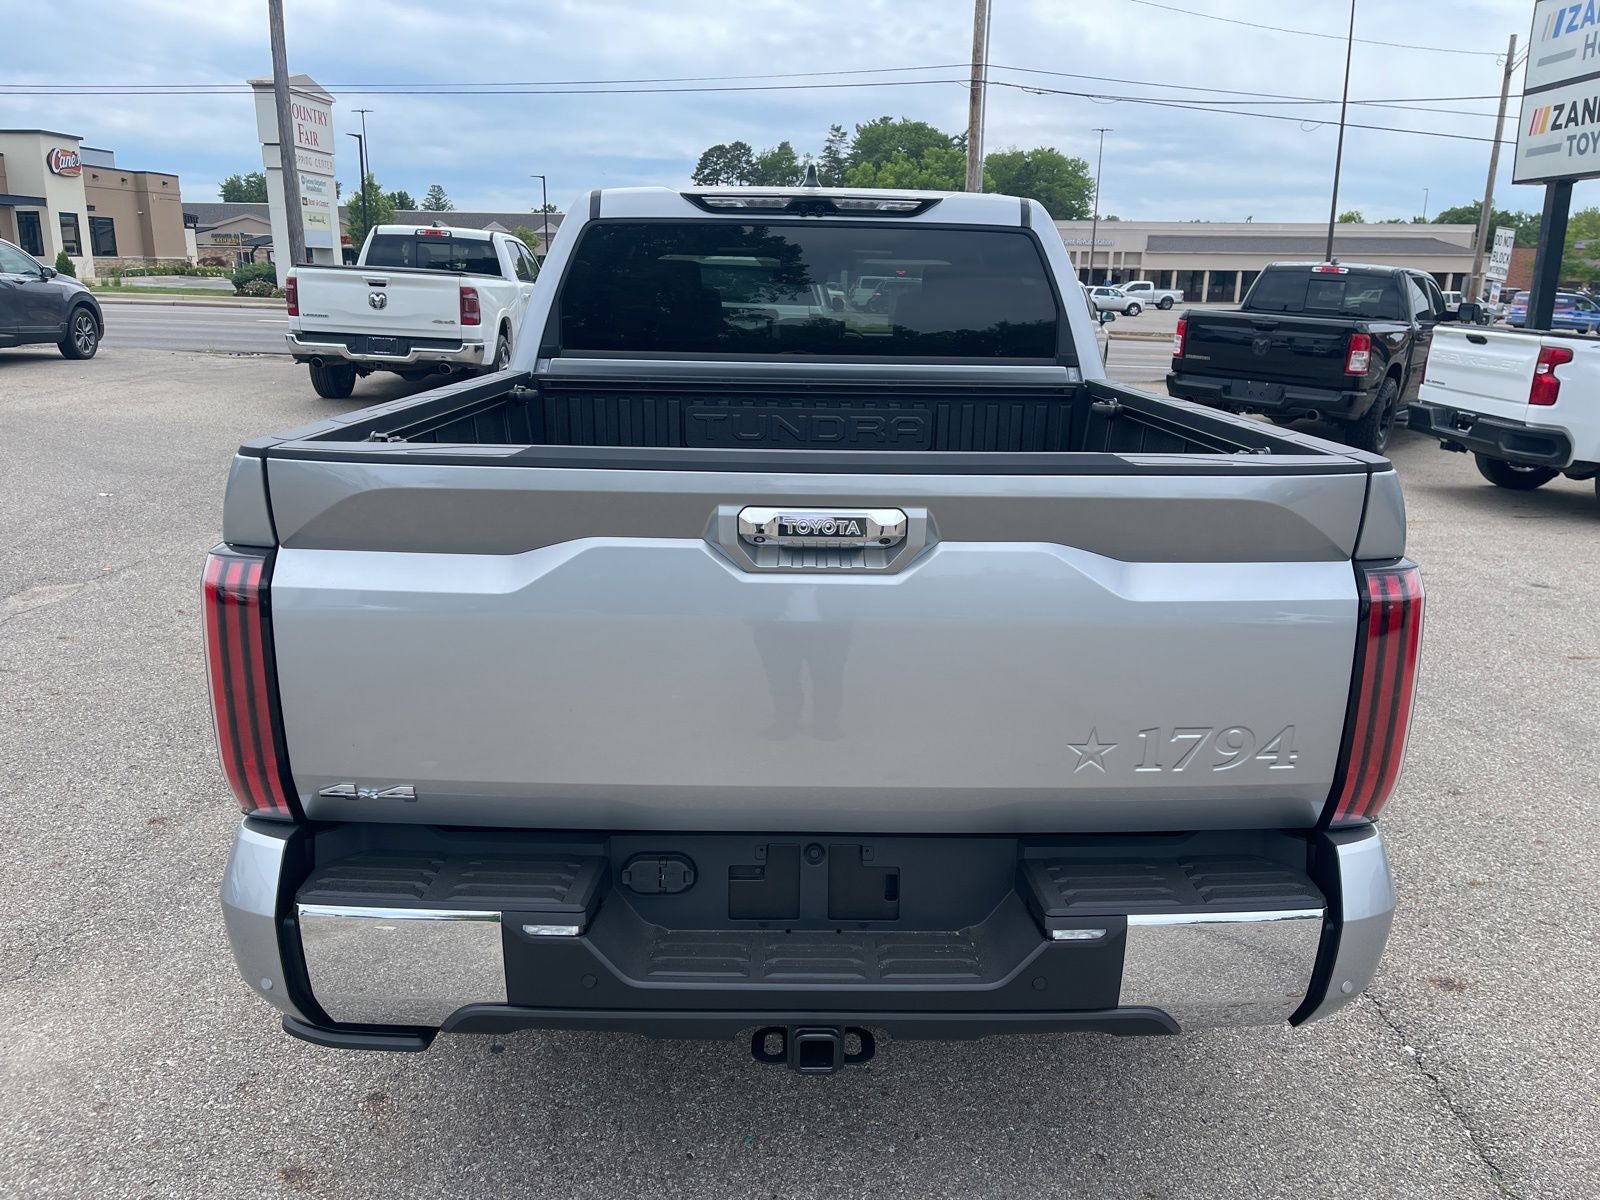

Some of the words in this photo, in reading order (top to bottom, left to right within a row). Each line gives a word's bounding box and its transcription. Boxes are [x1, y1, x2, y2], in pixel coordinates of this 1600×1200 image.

[1565, 0, 1600, 34] ZA
[291, 103, 328, 127] OUNTRY
[1550, 95, 1600, 131] ZAN
[1491, 250, 1510, 265] BLOCK
[693, 413, 925, 442] TUNDRA
[783, 518, 861, 536] TOYOTA
[1134, 725, 1299, 772] 1794
[319, 783, 416, 800] 4x4
